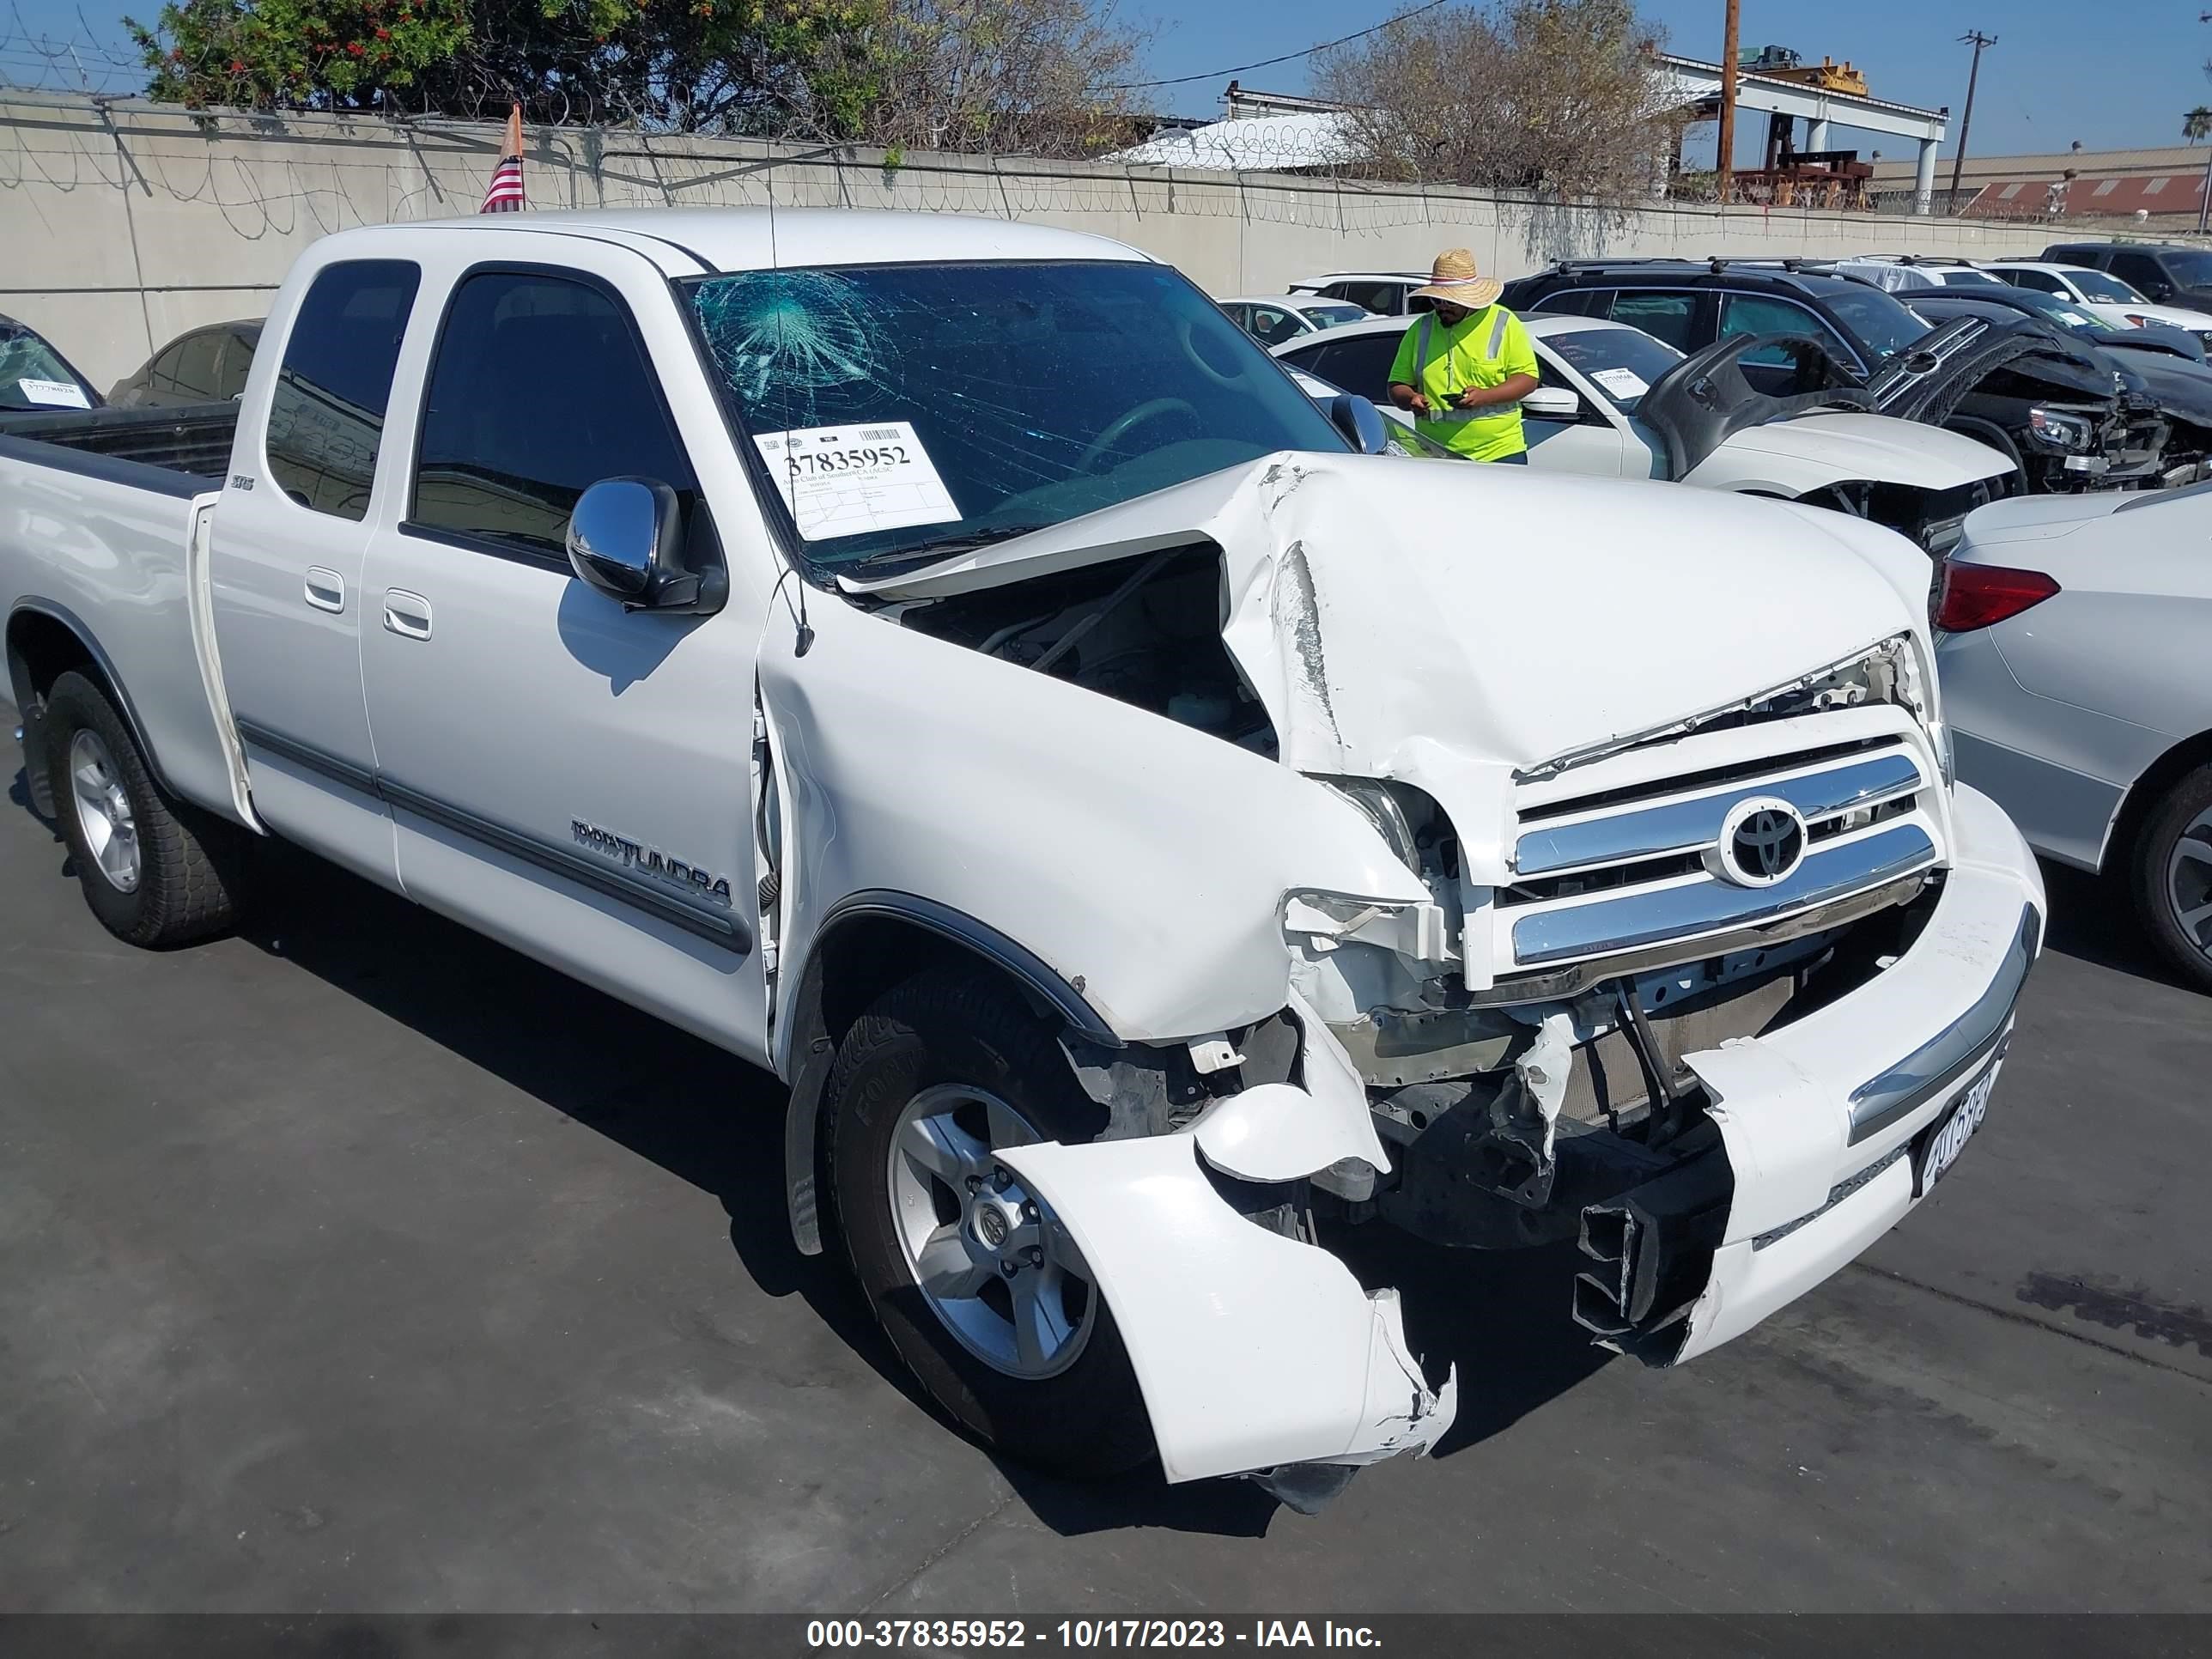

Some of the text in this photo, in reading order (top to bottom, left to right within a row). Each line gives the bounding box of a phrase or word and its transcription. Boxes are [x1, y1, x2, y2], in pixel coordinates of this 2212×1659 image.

[783, 446, 911, 477] 37835952
[799, 475, 817, 483] Club
[826, 470, 857, 479] Southern
[571, 819, 732, 898] TOYOTA TUNDRA
